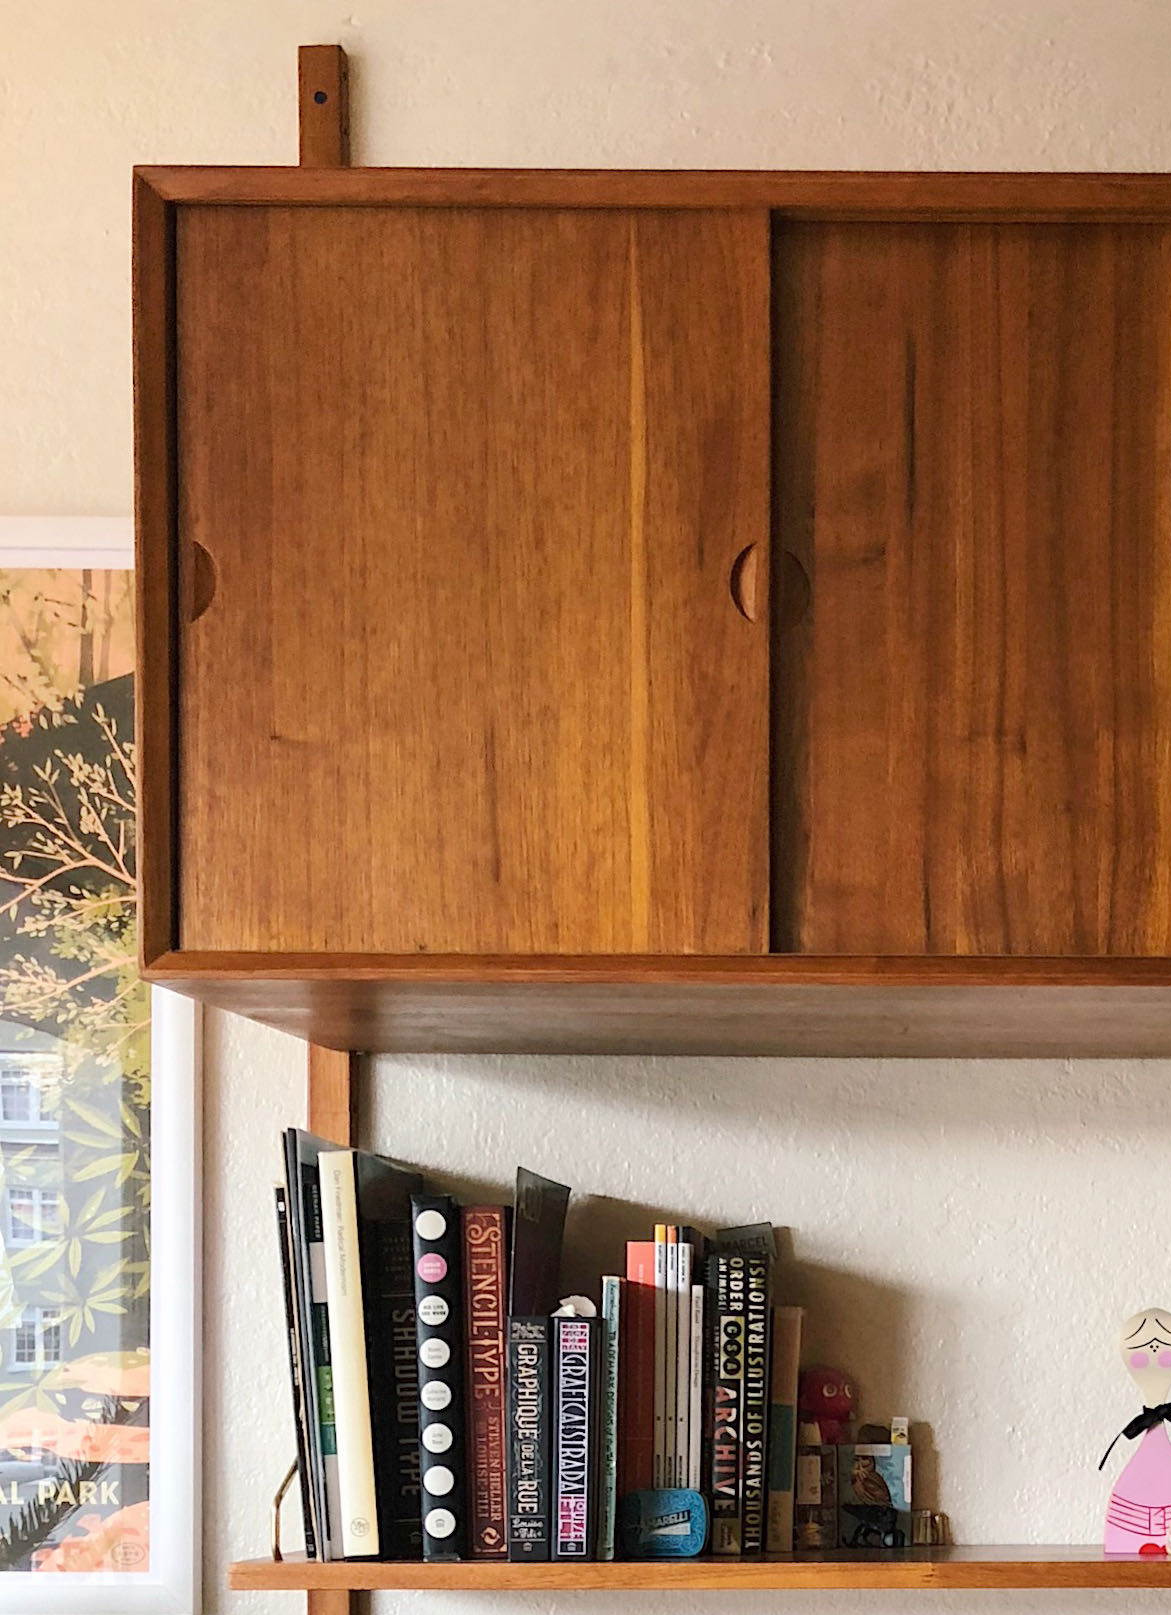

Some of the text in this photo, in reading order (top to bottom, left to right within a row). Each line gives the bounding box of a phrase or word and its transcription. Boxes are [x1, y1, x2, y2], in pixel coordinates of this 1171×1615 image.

[719, 1257, 727, 1271] AN
[729, 1256, 744, 1312] ORDER
[470, 1331, 503, 1400] TYPE
[515, 1343, 538, 1440] GRAPHIQUE
[745, 1259, 766, 1549] THOUSANDS OF ILLUSTRATIONS!
[560, 1431, 586, 1492] STRADA
[714, 1386, 737, 1513] ARCHIVE
[38, 1481, 120, 1506] PARK
[490, 1470, 503, 1522] HELLER
[517, 1480, 538, 1513] RUE
